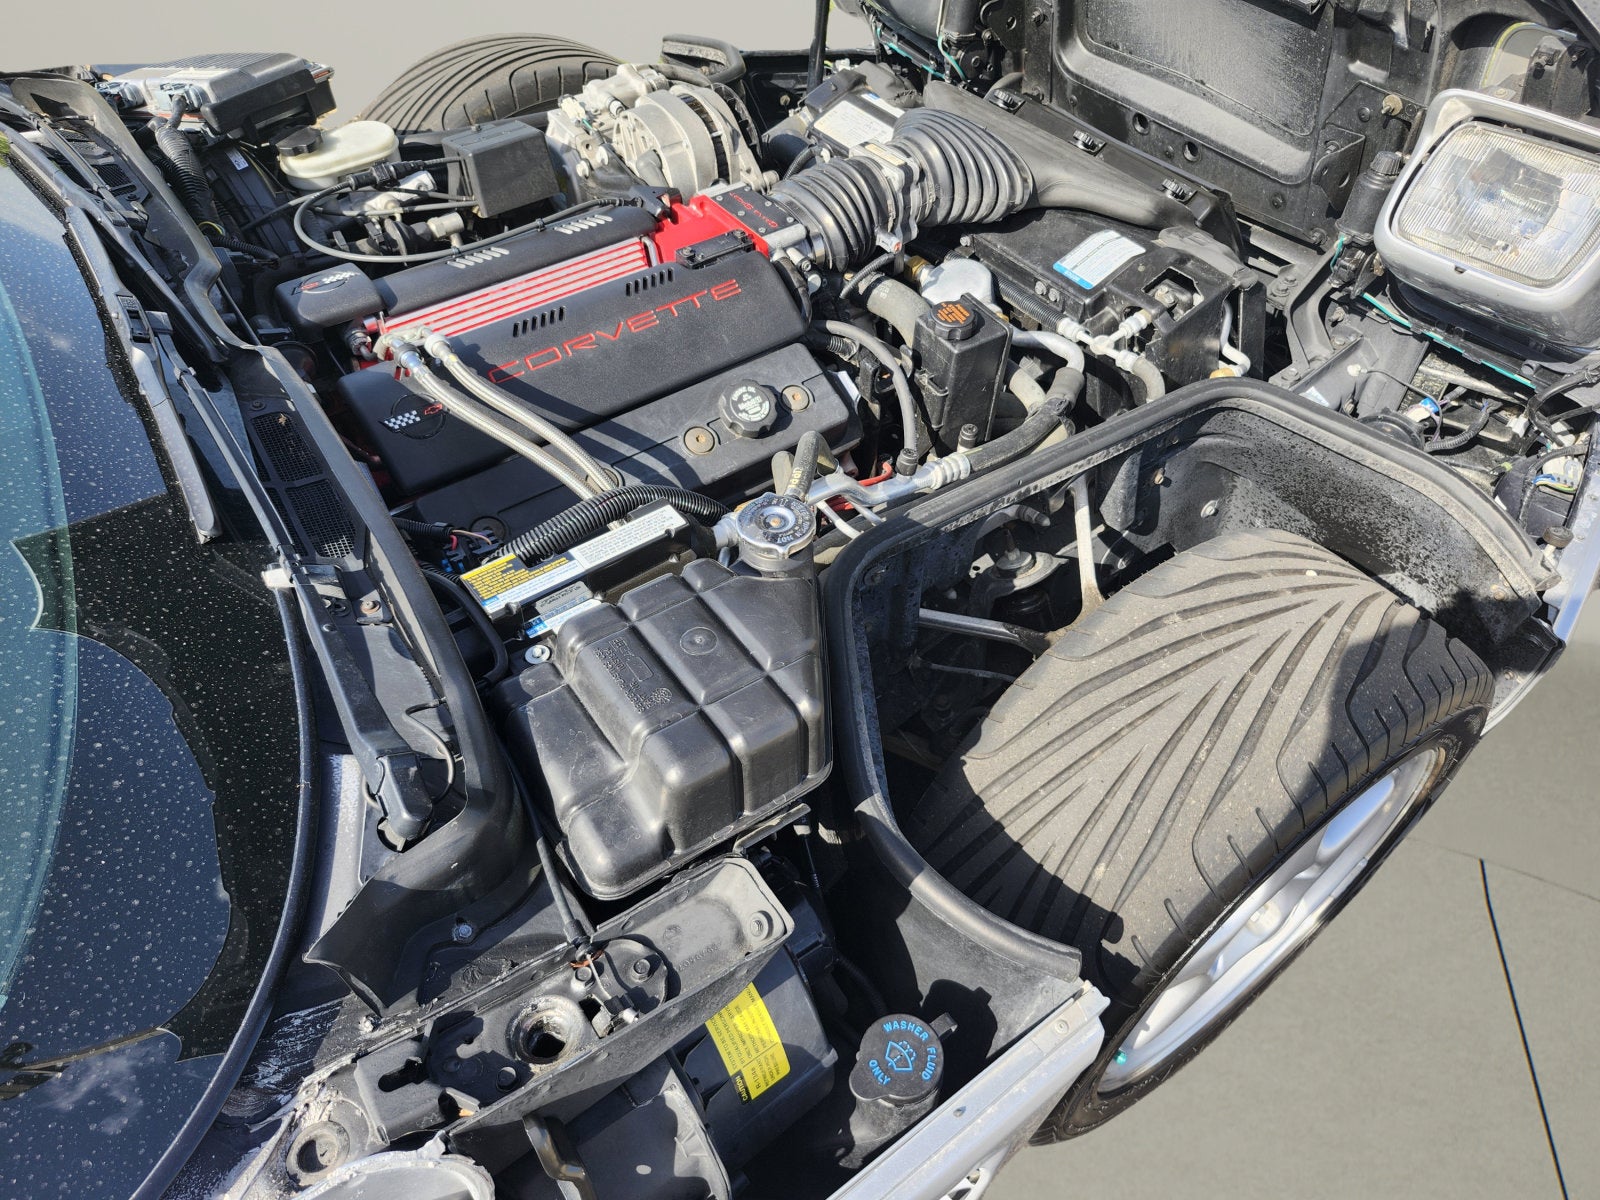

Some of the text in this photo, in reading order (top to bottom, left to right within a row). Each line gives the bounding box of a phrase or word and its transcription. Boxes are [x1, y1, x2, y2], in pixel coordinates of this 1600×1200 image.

[488, 279, 742, 384] CORVETTE
[868, 1059, 891, 1085] ONLY
[883, 1020, 936, 1082] WASHER FLUID
[734, 1075, 748, 1101] CAUTION
